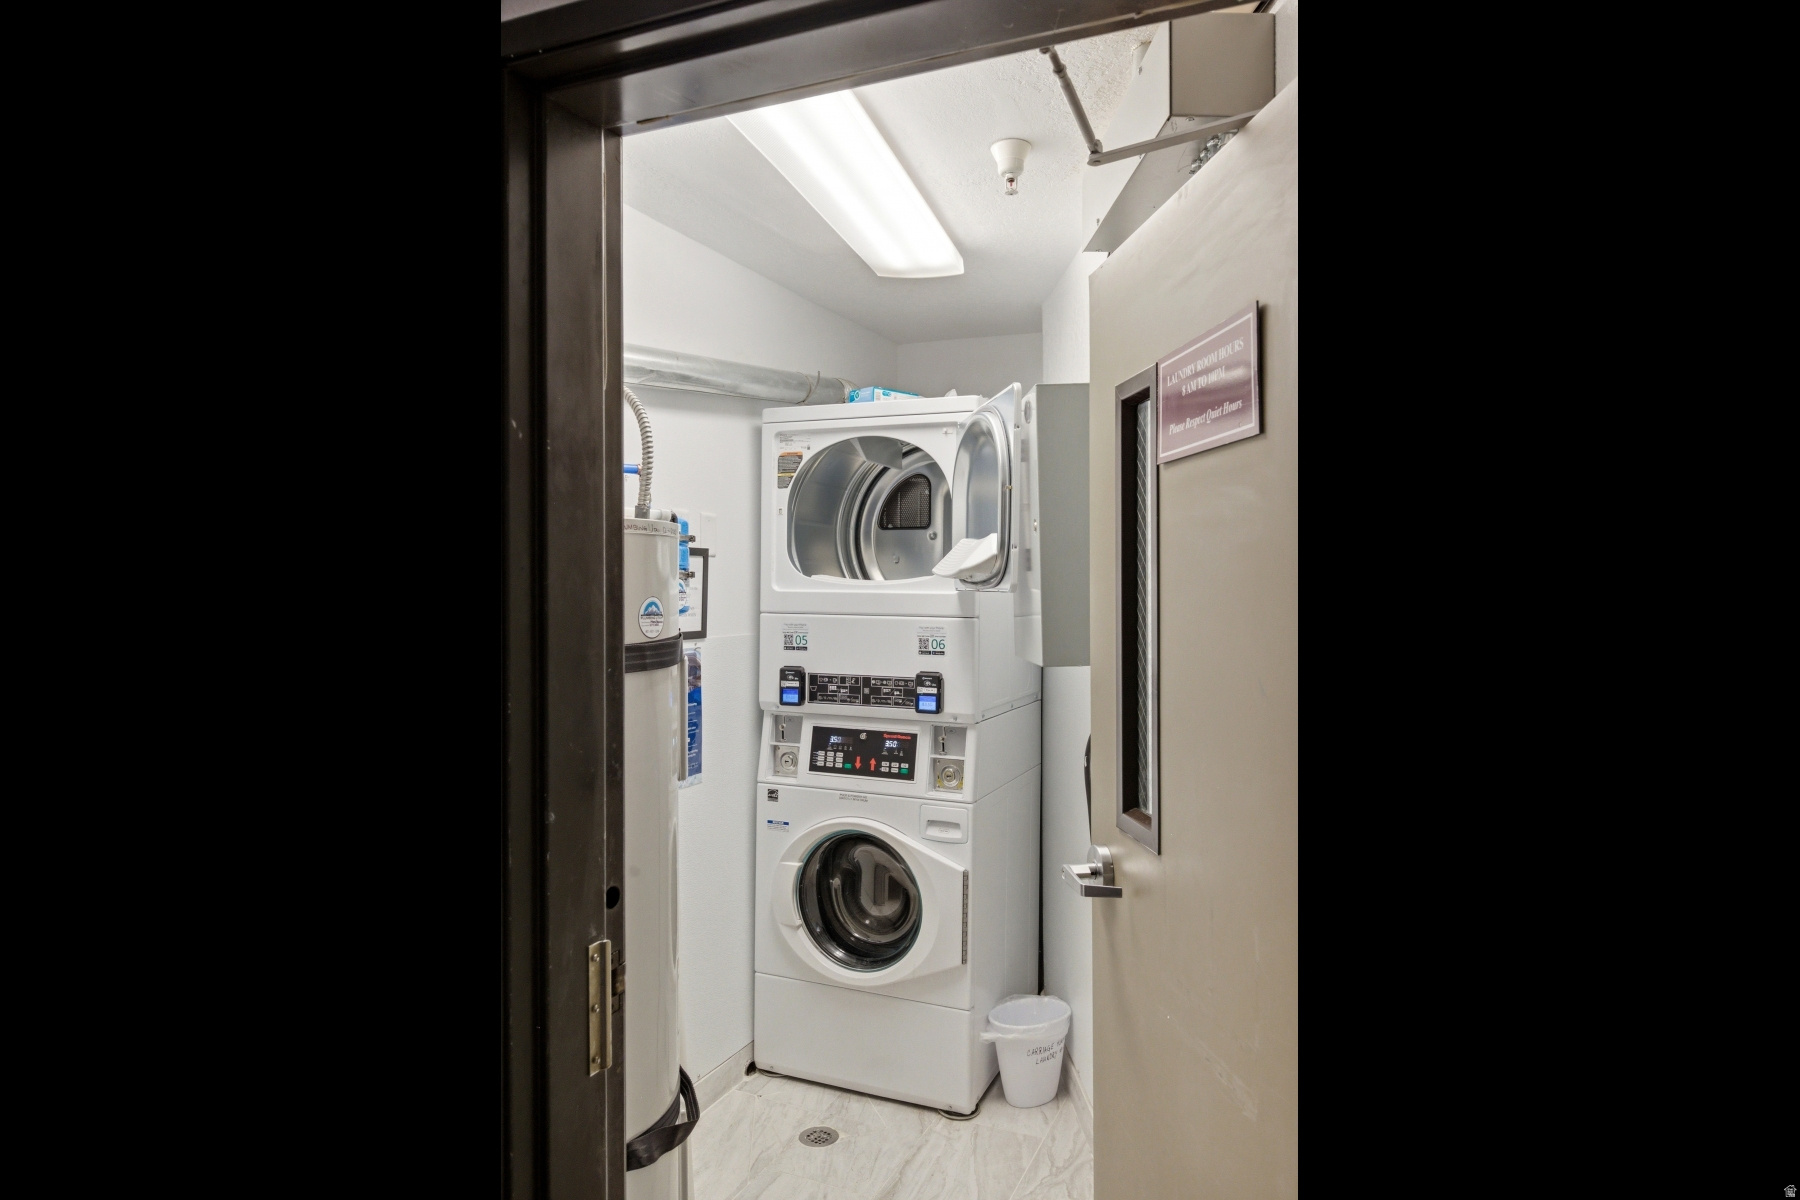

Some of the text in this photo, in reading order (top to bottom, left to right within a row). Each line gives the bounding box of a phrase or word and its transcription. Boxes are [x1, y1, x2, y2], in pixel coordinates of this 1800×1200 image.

[1167, 336, 1244, 387] LAUNDRY ROOM HOURS
[1181, 384, 1186, 396] 8
[1186, 378, 1197, 394] AM
[1197, 374, 1207, 389] TO
[1169, 399, 1243, 435] Please Respect Quiet Hours
[795, 634, 808, 646] 05
[931, 638, 946, 650] 06
[1026, 1042, 1055, 1057] CARRIAGE
